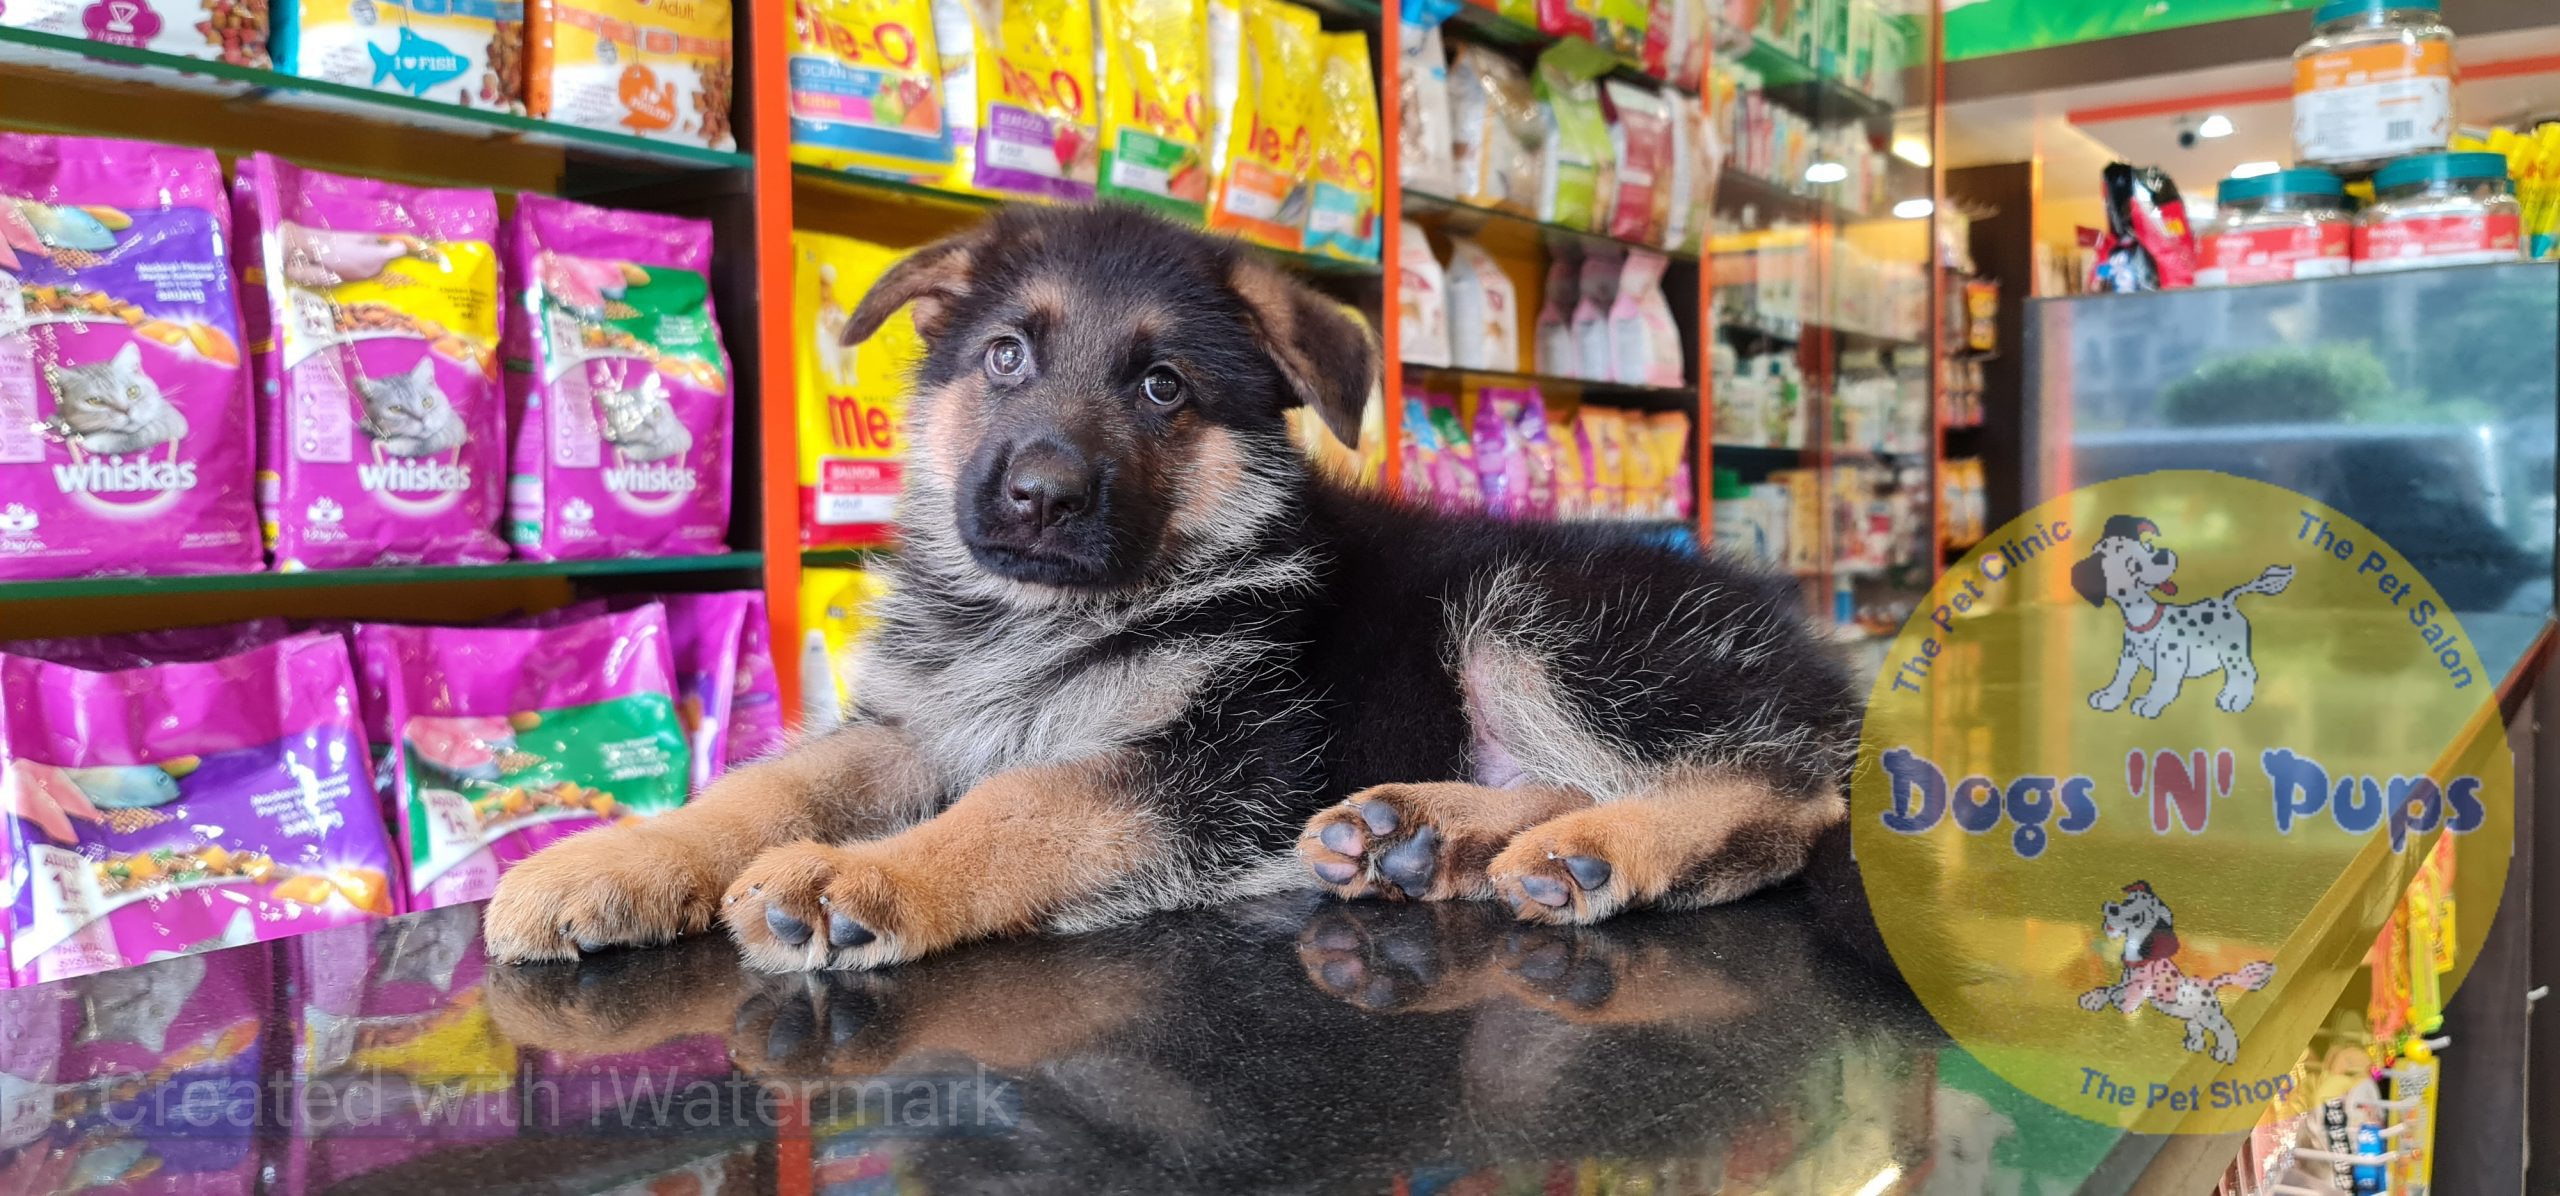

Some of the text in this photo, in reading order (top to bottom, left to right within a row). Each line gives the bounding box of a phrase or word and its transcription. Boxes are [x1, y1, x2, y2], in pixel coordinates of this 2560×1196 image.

[419, 55, 457, 71] FISH
[53, 455, 198, 493] whiskas
[358, 457, 471, 491] whiskas
[604, 461, 697, 492] whiskas
